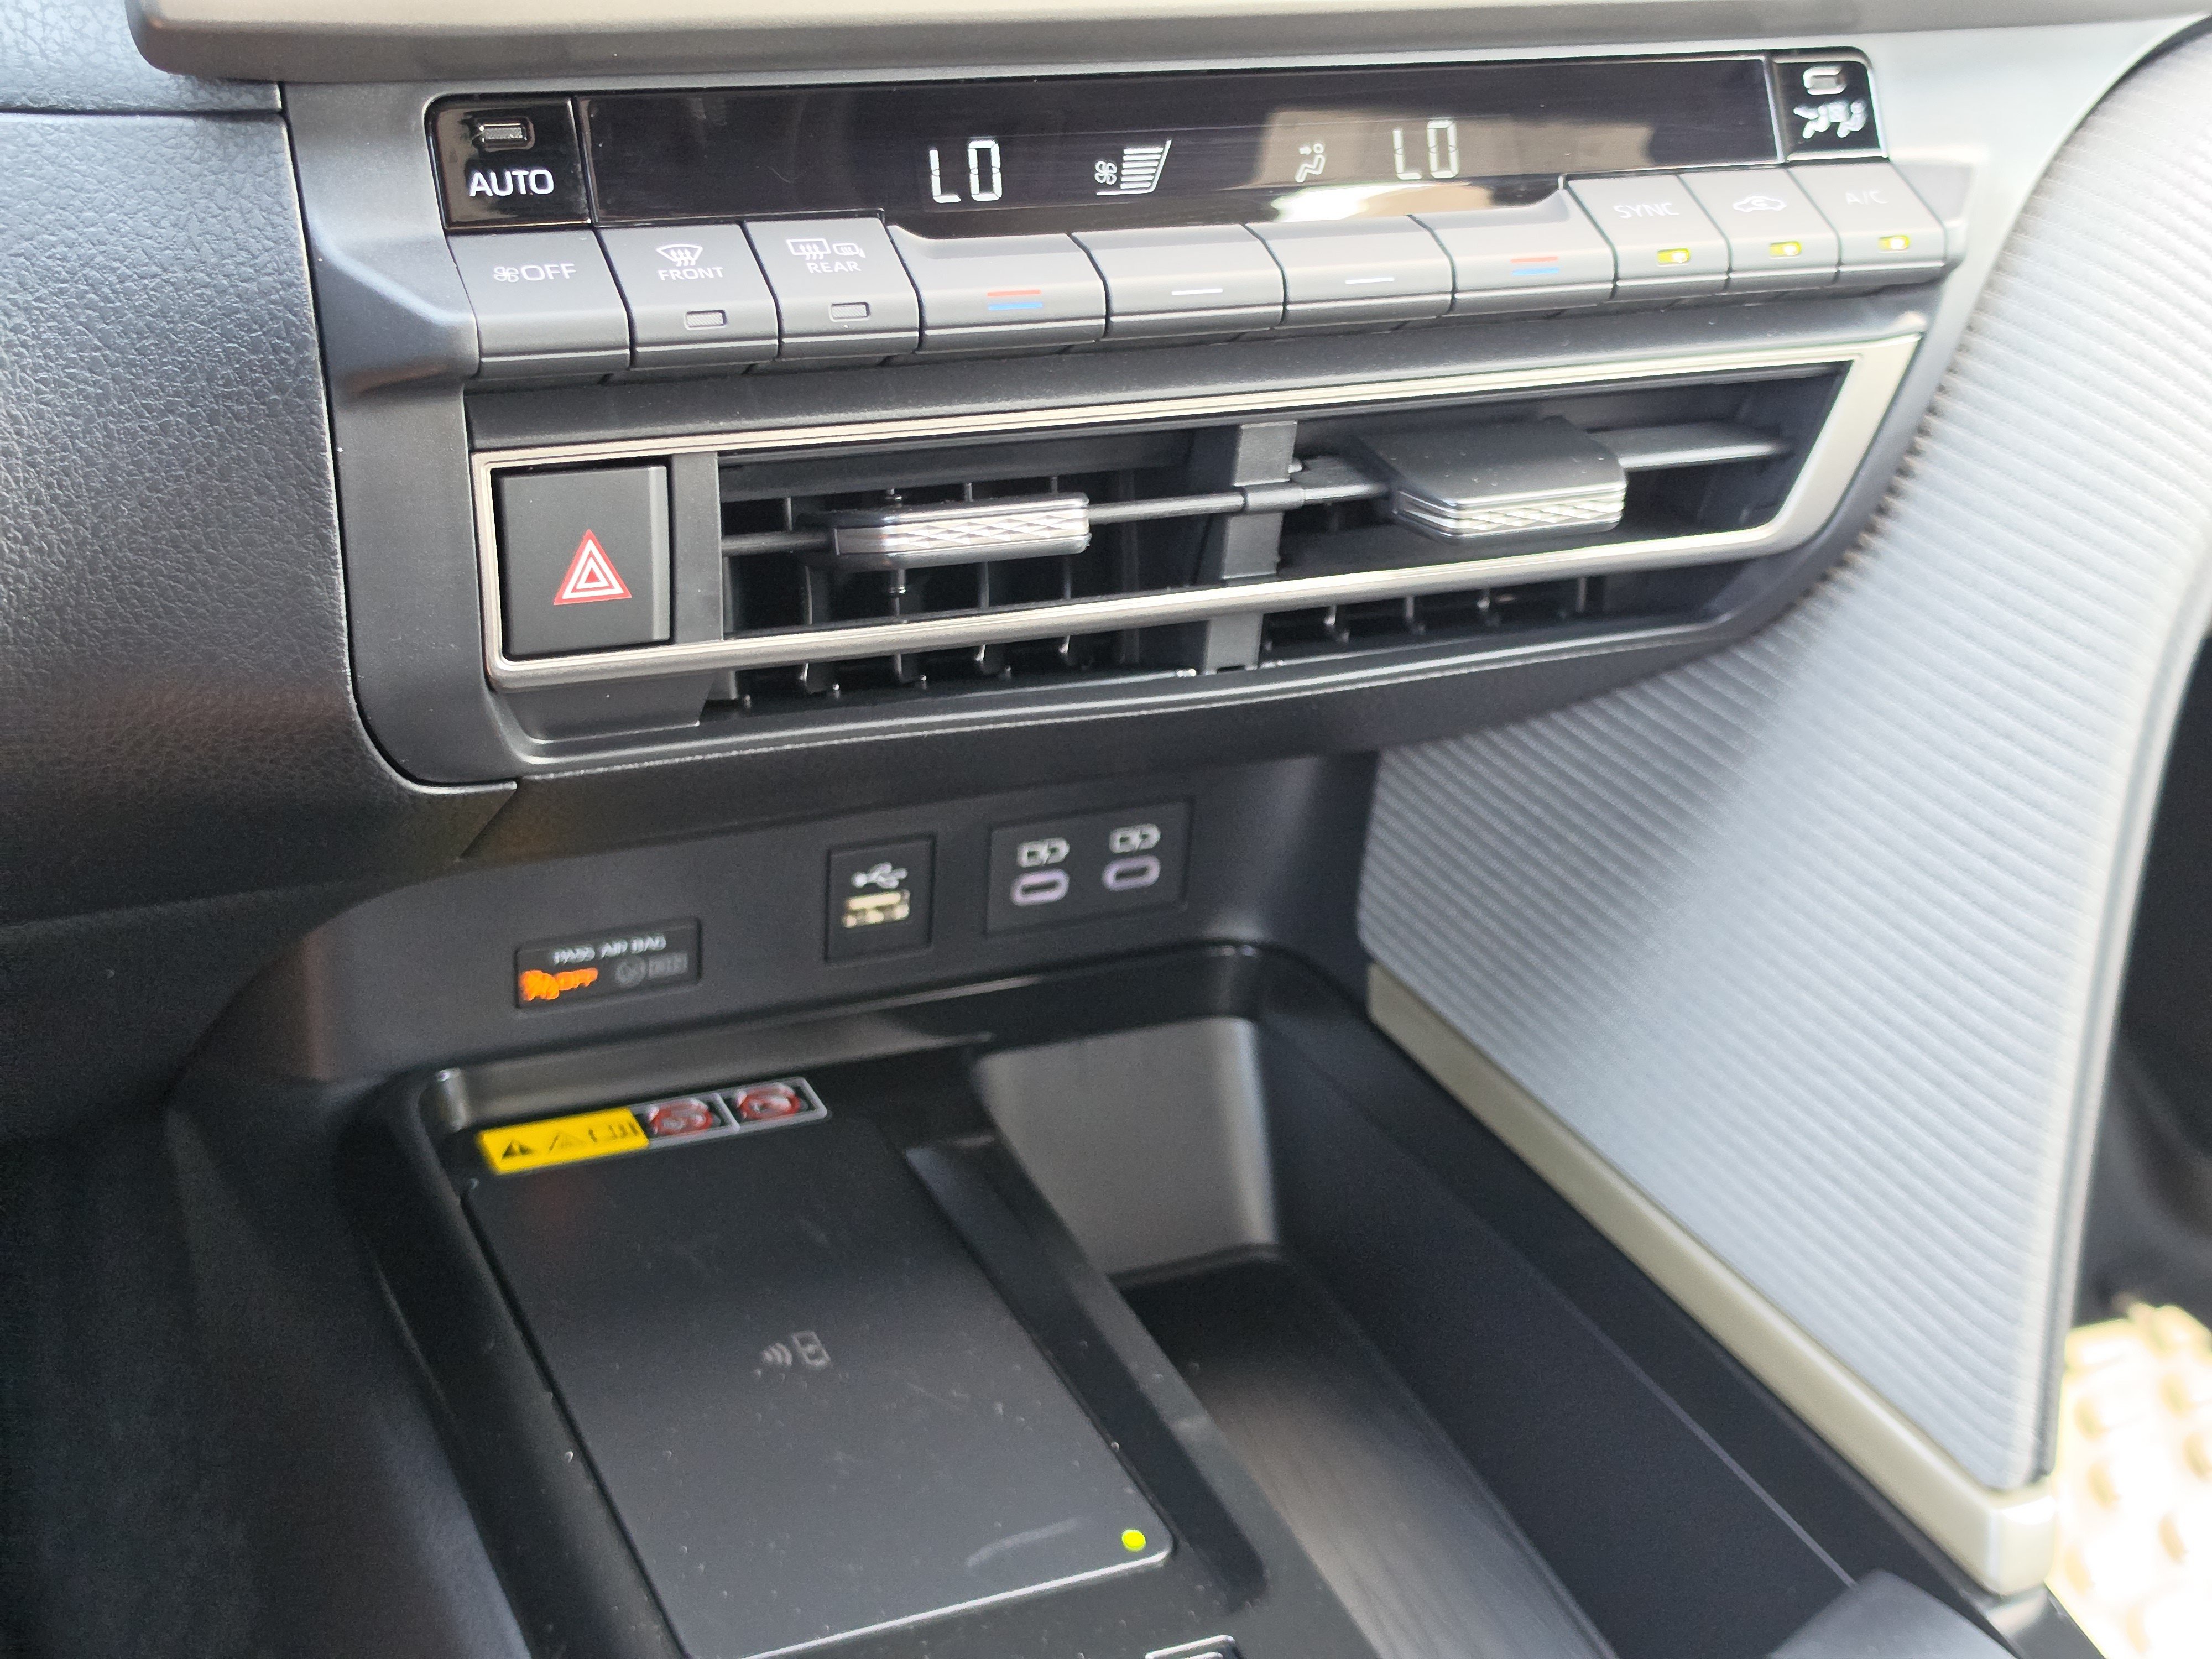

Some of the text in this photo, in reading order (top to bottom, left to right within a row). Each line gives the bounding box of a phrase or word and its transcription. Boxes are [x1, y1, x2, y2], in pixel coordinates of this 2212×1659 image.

[469, 168, 554, 197] AUTO
[1846, 190, 1888, 205] A/C
[1614, 202, 1679, 218] SYNC
[521, 263, 576, 282] OFF
[658, 267, 723, 281] FRONT
[808, 260, 861, 274] REAR
